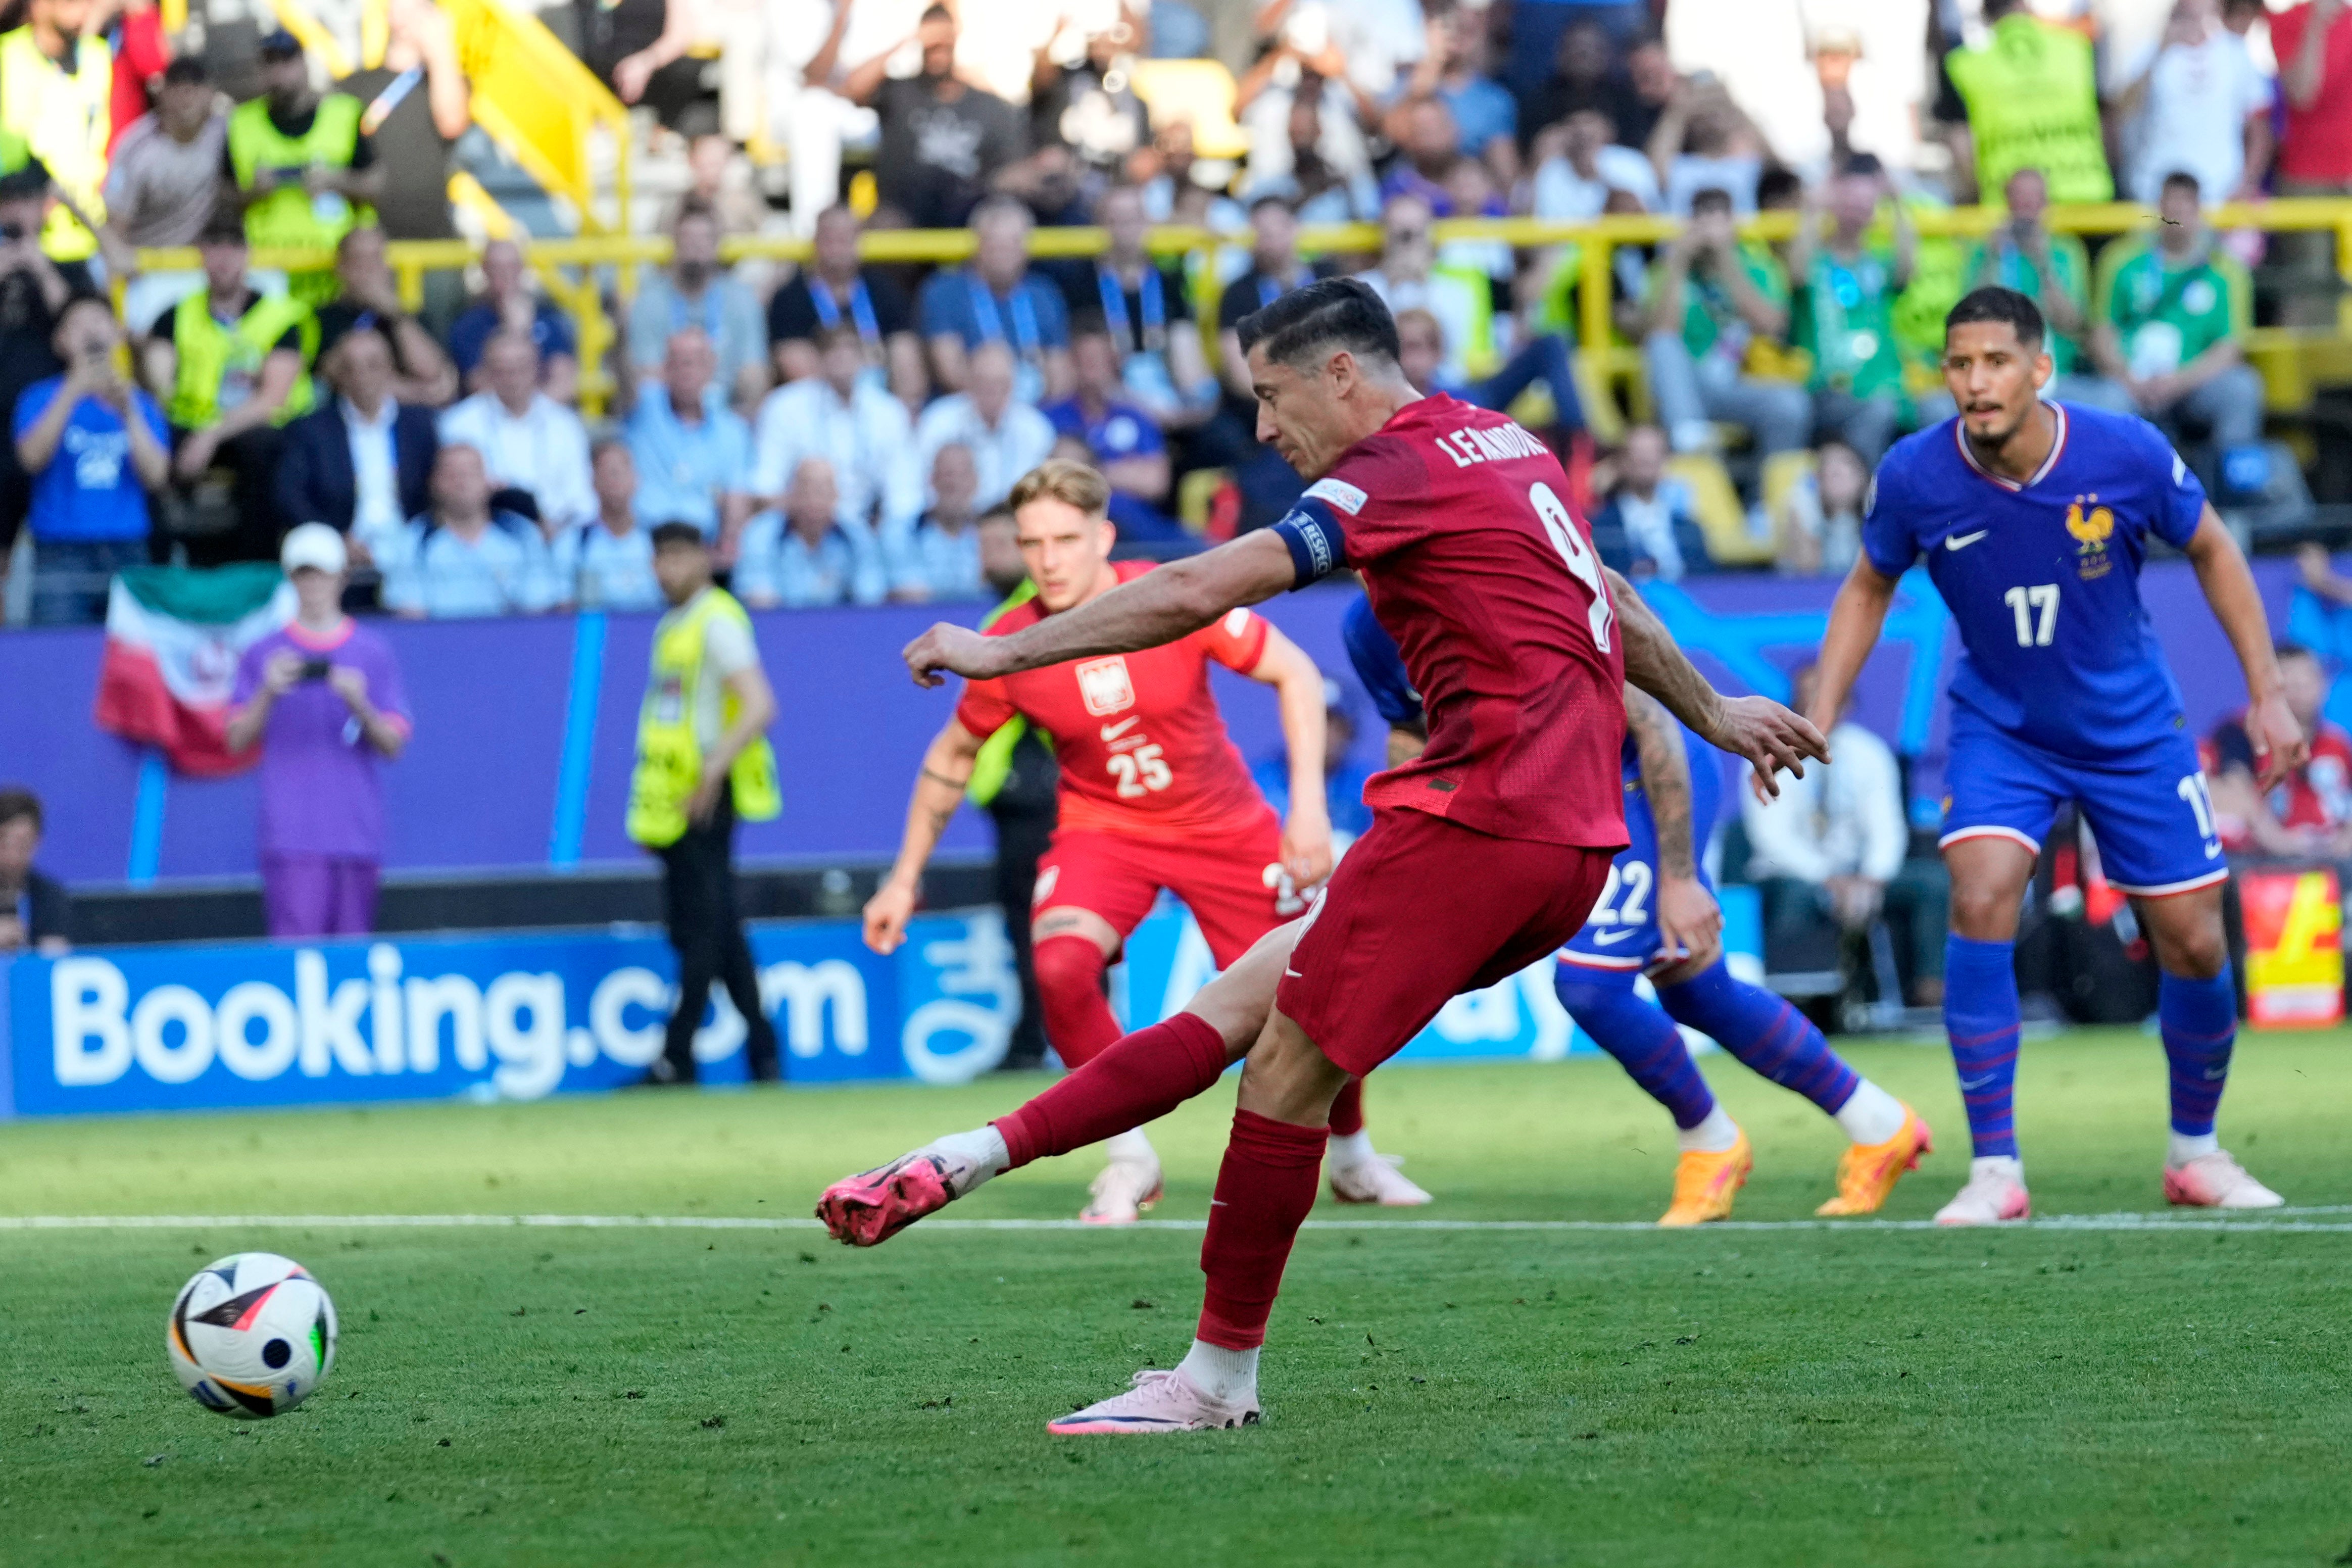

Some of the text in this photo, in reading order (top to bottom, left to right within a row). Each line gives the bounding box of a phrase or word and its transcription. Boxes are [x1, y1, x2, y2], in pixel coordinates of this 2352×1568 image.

[1300, 524, 1329, 572] RESPEC
[1529, 481, 1612, 654] 9
[2004, 583, 2061, 648] 17
[1106, 743, 1173, 798] 25
[1586, 860, 1653, 926] 22
